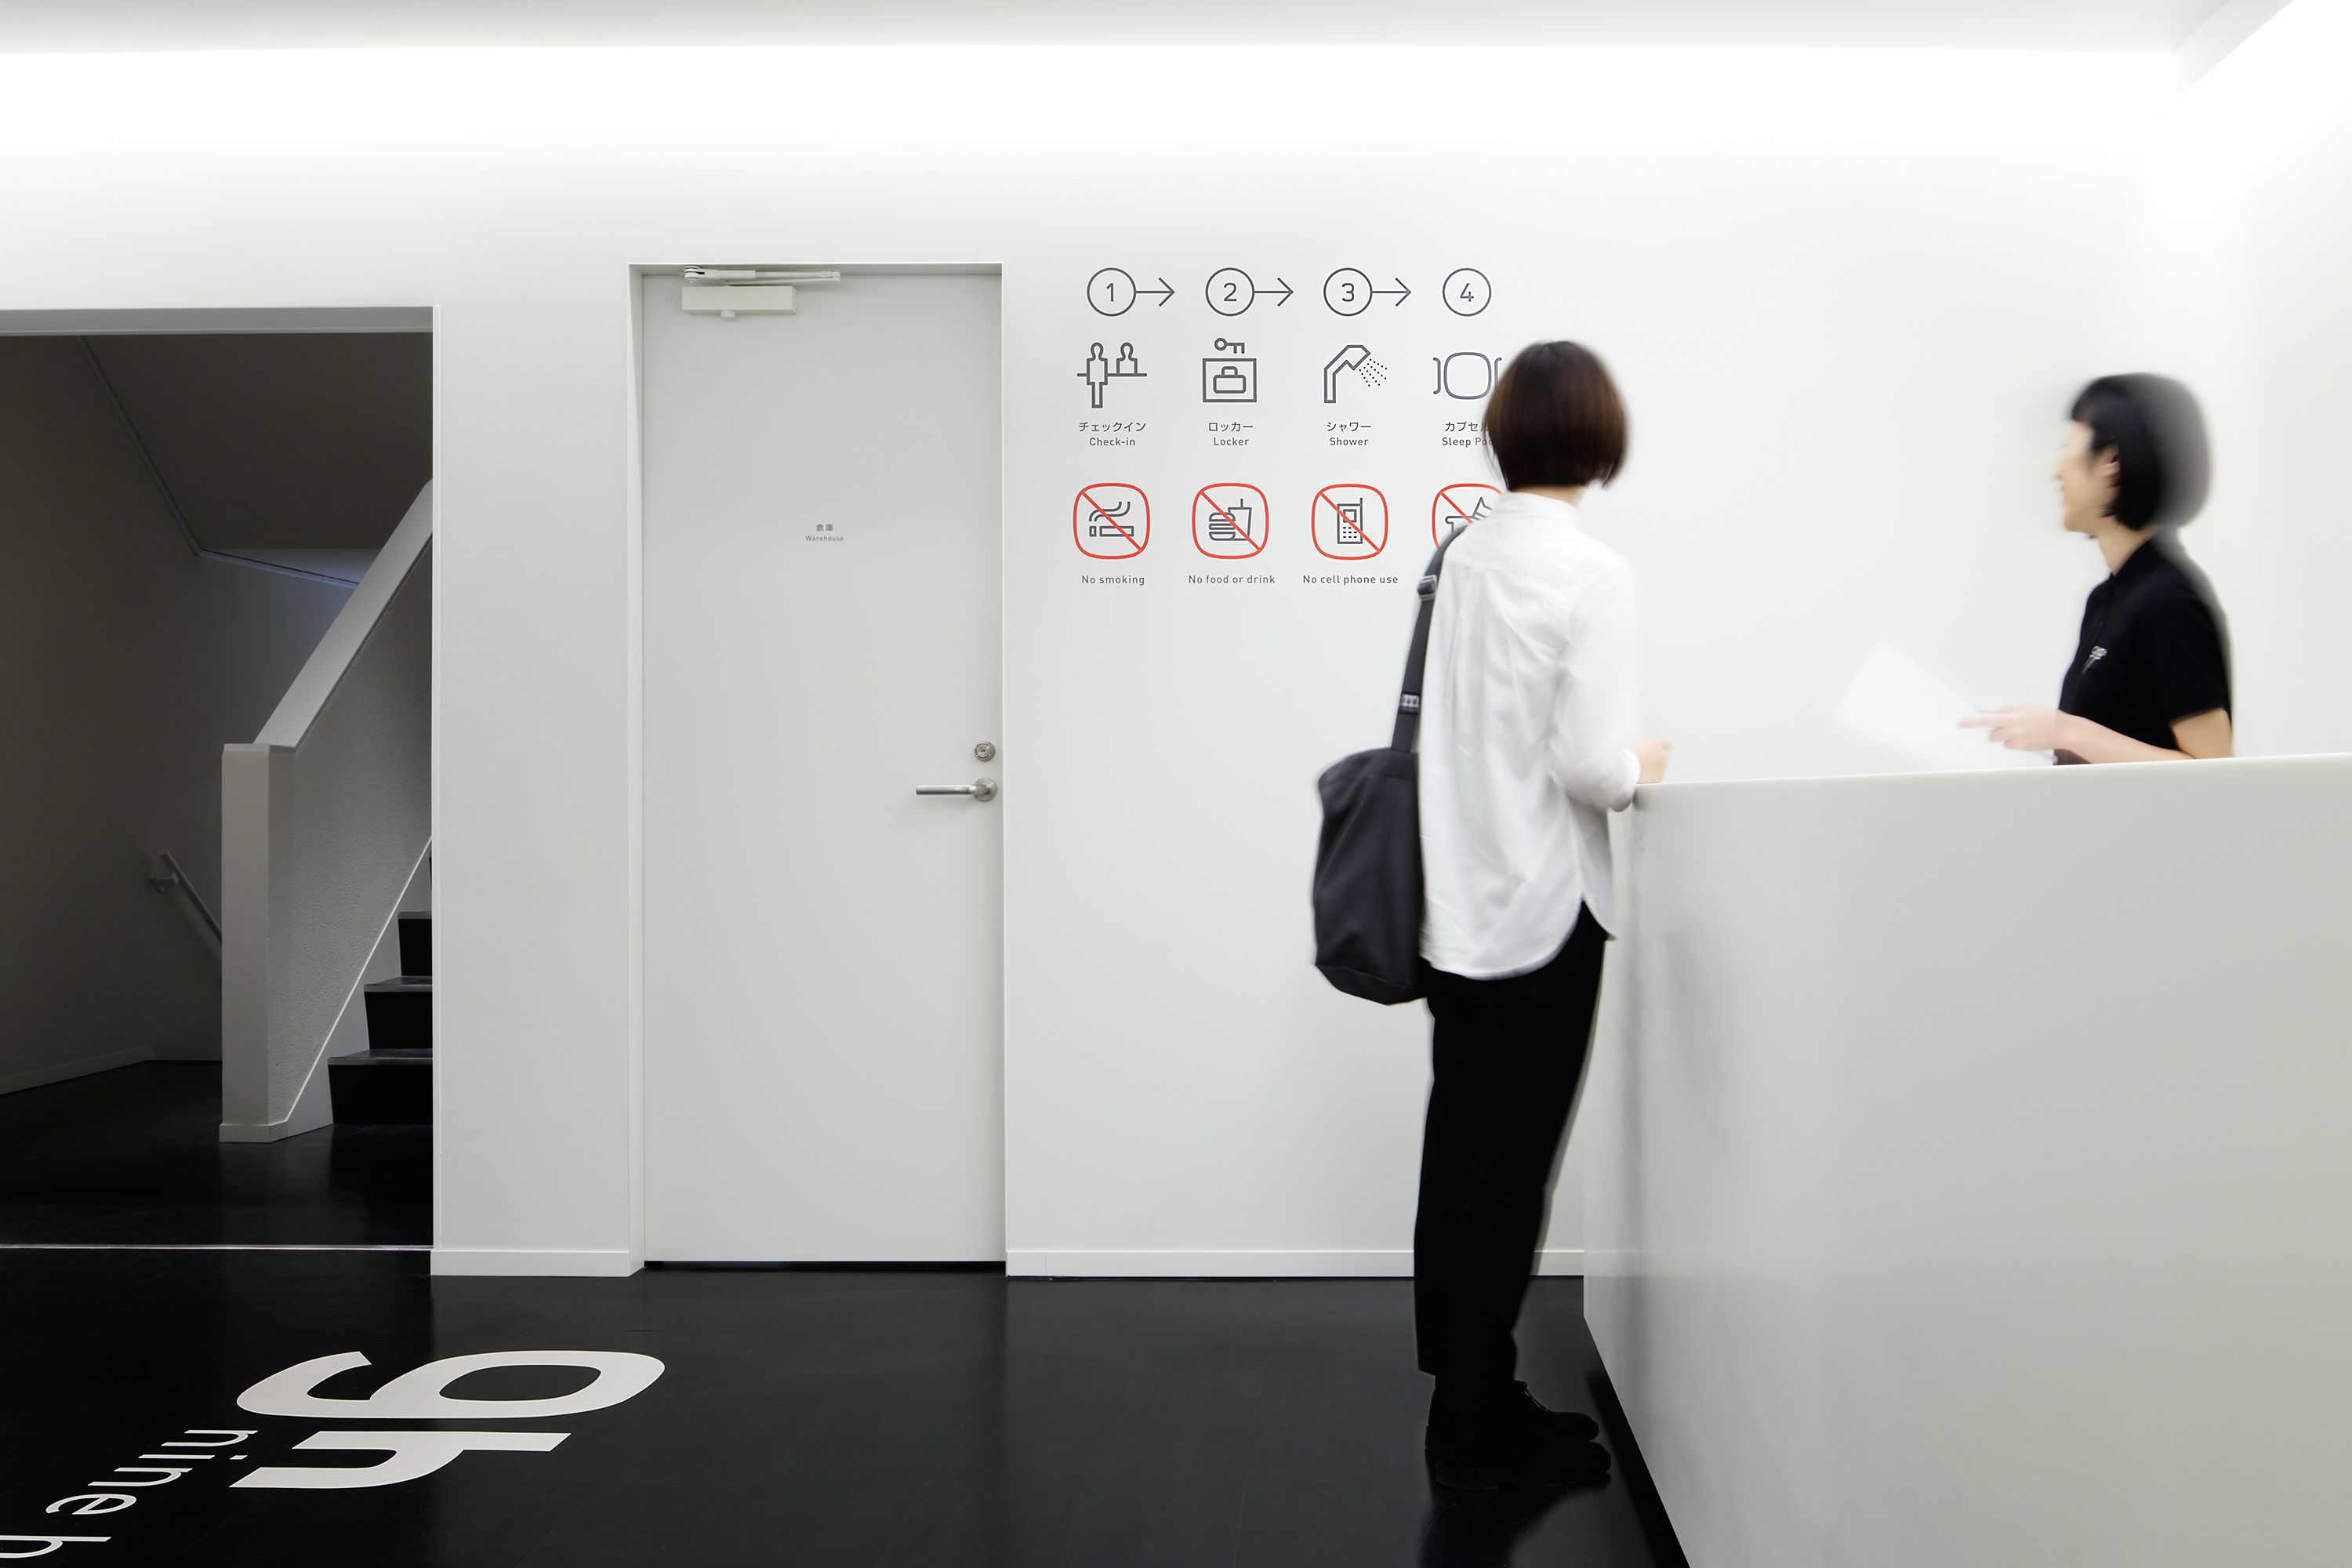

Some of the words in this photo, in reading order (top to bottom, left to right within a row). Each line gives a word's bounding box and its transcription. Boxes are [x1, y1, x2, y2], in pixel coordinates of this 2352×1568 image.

[1105, 282, 1114, 303] 1
[1223, 282, 1237, 302] 2
[1341, 282, 1355, 303] 3
[1459, 282, 1475, 303] 4
[1078, 421, 1146, 433] チェックイン
[1208, 421, 1254, 433] ロッカー
[1327, 422, 1372, 432] シャワー
[1089, 437, 1135, 446] Check-in
[1213, 437, 1250, 446] Locker
[1329, 437, 1369, 446] Shower
[1442, 437, 1472, 448] Sleep
[1081, 575, 1096, 584] No
[1098, 575, 1145, 586] smoking
[1189, 575, 1203, 584] No
[1206, 574, 1229, 584] food
[1247, 575, 1276, 584] drink
[1302, 575, 1317, 584] No
[1320, 575, 1341, 584] cell
[1343, 575, 1376, 586] phone
[229, 1351, 665, 1488] 9h
[46, 1430, 258, 1515] nine
